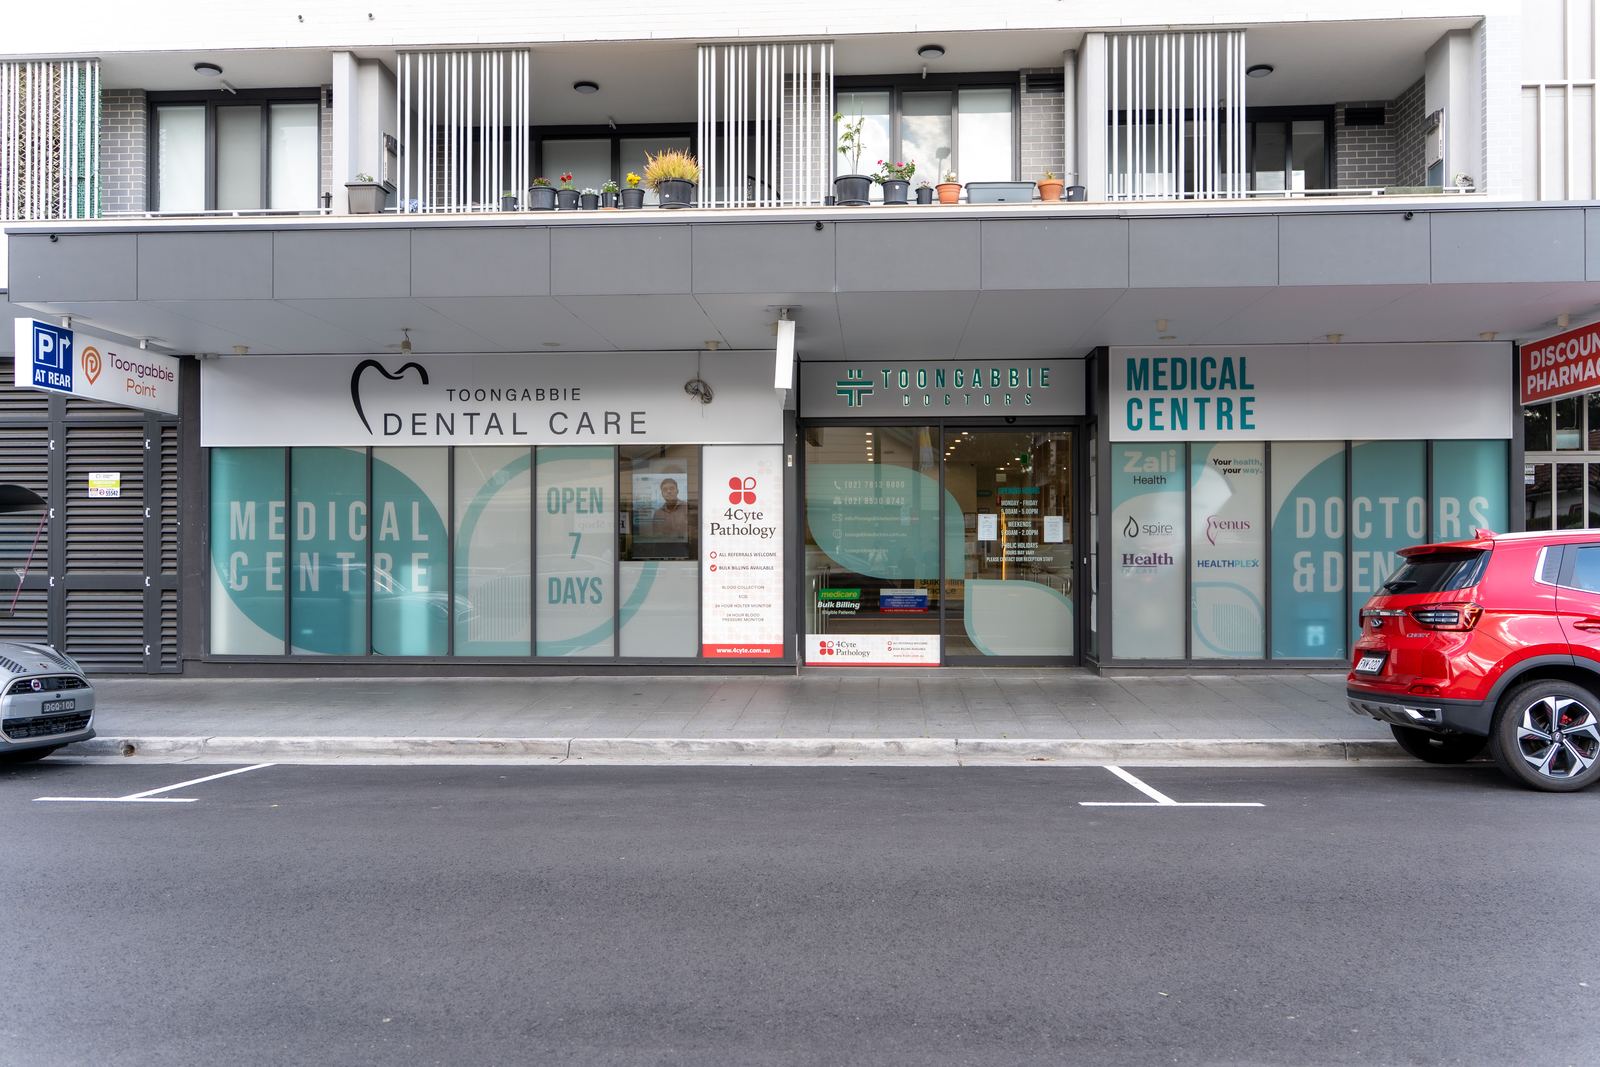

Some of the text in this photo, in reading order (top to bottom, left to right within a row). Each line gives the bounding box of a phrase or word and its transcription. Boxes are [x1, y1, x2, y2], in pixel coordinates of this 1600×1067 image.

[38, 333, 53, 360] P
[108, 352, 174, 382] Toongabbie
[1127, 357, 1254, 391] MEDICAL
[35, 370, 71, 387] AT REAR
[126, 378, 156, 398] Point
[881, 367, 1051, 389] TOONGABBIE
[446, 388, 581, 402] TOONGABBIE
[903, 394, 1032, 406] DOCTORS
[384, 411, 646, 436] DENTAL CARE
[1127, 397, 1255, 431] CENTRE
[1123, 449, 1177, 472] Zali
[1134, 475, 1166, 484] Health
[546, 487, 603, 514] OPEN
[230, 501, 429, 541] MEDICAL
[724, 508, 763, 523] 4Cyte
[1213, 520, 1250, 530] venus
[1296, 496, 1489, 539] DOCTORS
[710, 523, 776, 538] Pathology
[1142, 522, 1173, 535] spire
[569, 532, 581, 559] 7
[1122, 553, 1173, 565] Health
[1198, 559, 1259, 568] HEALTHPLEX
[230, 552, 429, 592] CENTRE
[548, 576, 602, 605] DAYS
[836, 602, 860, 610] Billing
[836, 649, 870, 657] Pathology
